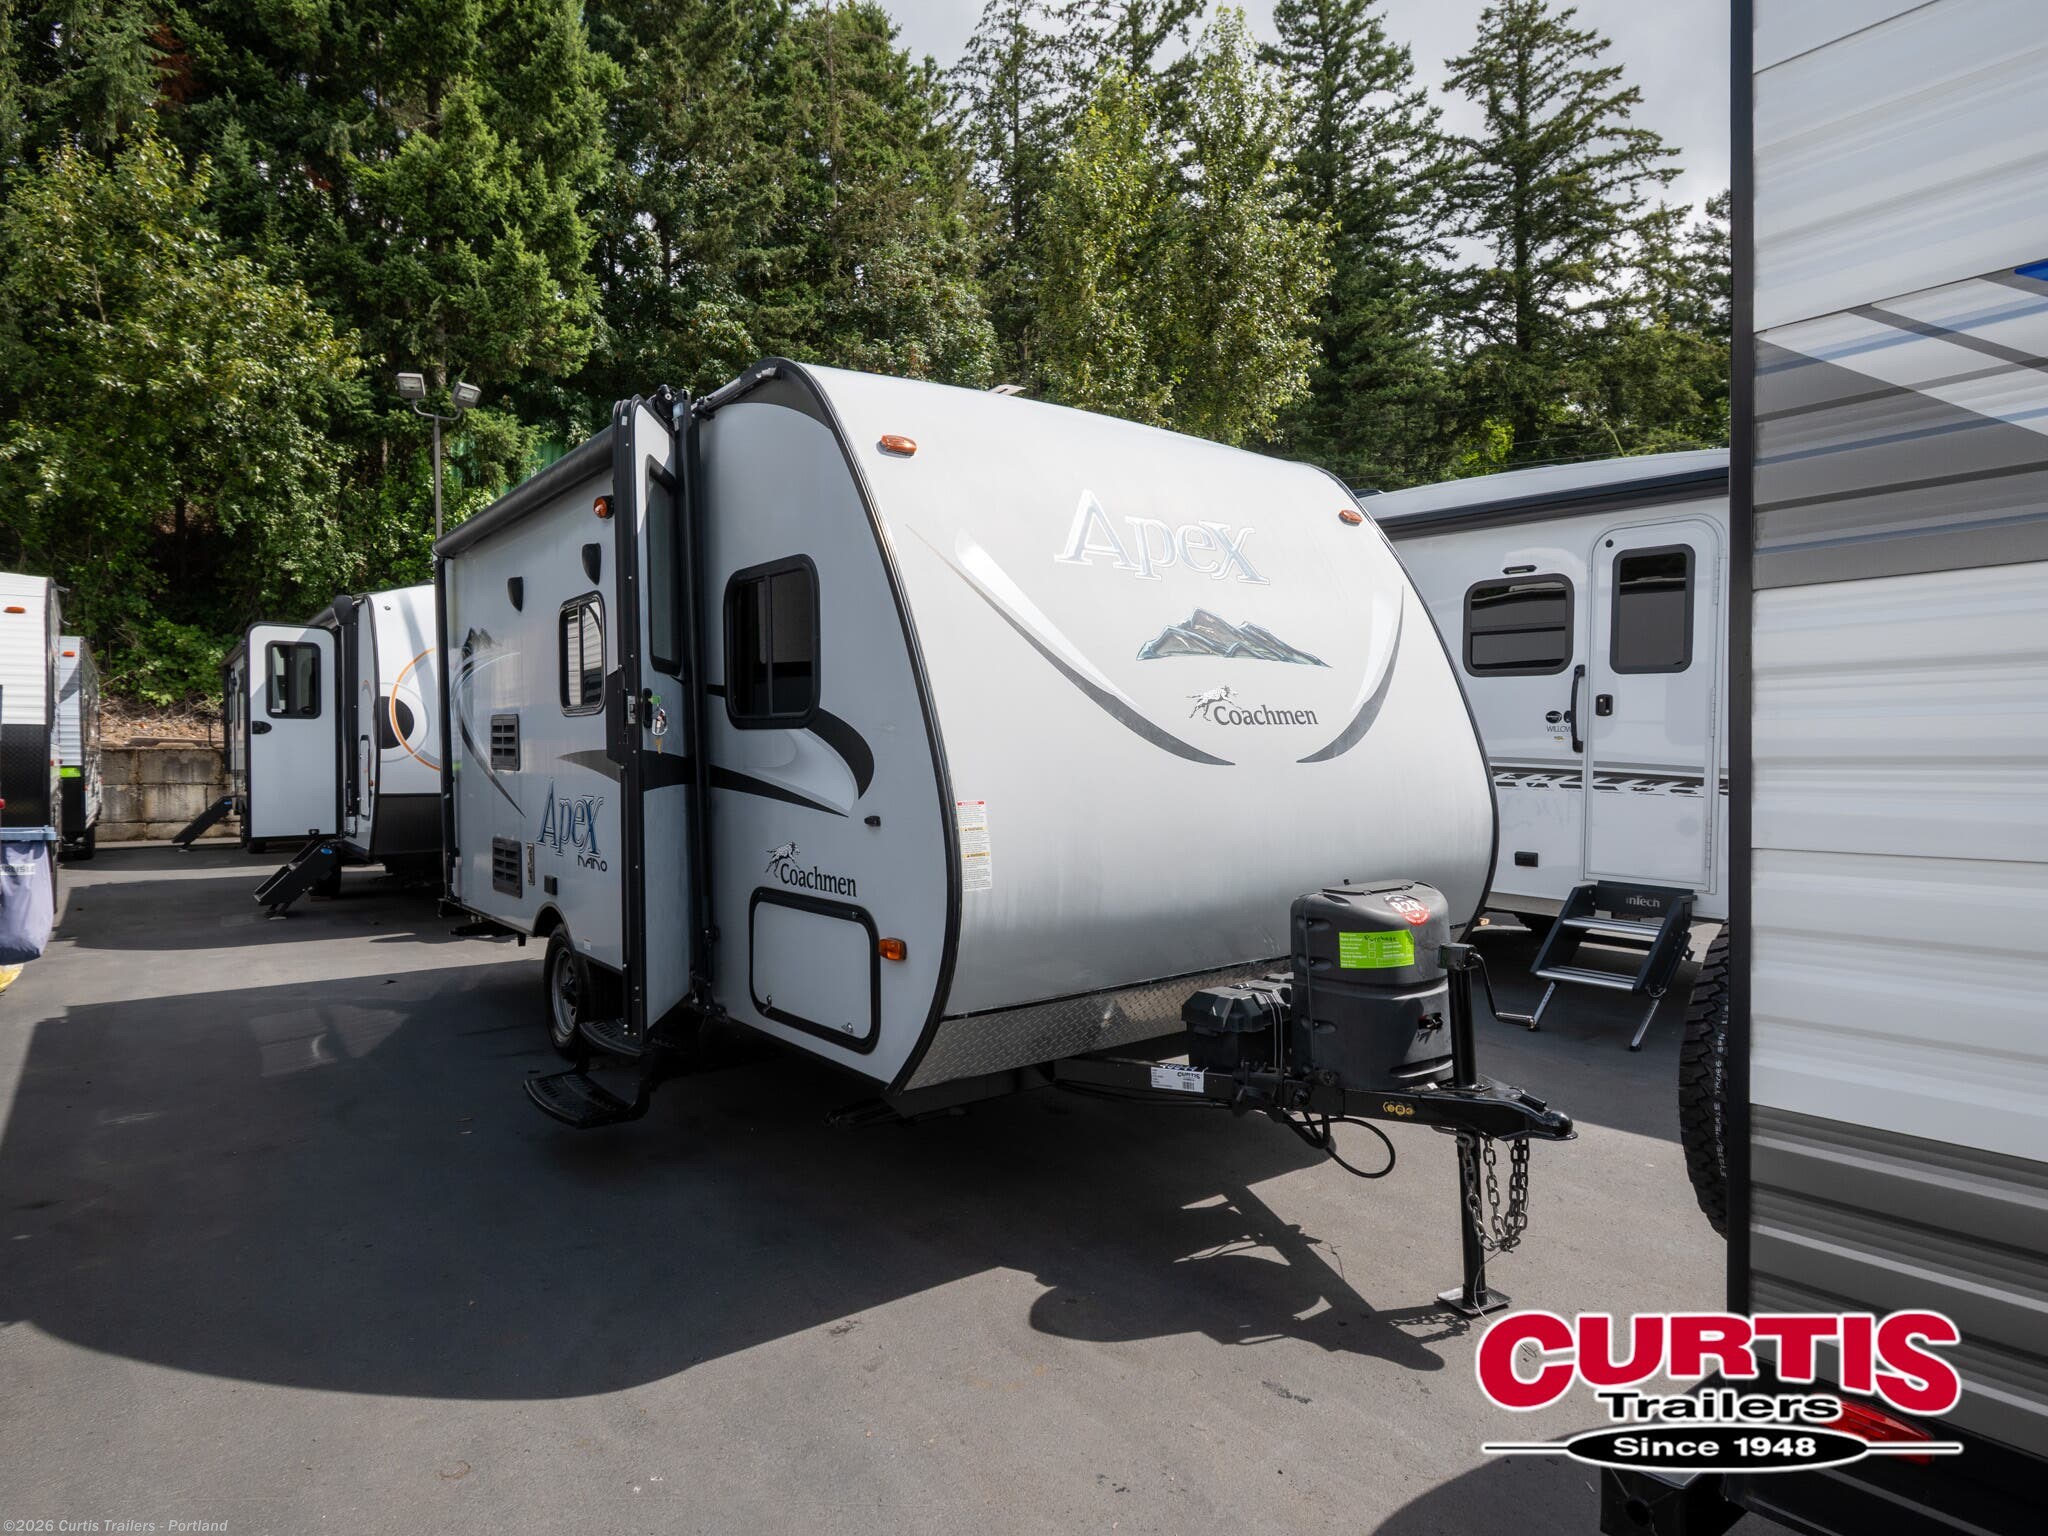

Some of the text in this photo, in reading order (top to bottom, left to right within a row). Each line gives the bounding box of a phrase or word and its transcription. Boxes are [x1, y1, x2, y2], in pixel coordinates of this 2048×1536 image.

[1054, 488, 1271, 585] Apex
[1213, 704, 1320, 726] Coachmen
[536, 776, 605, 858] Apex
[780, 863, 857, 897] Coachmen
